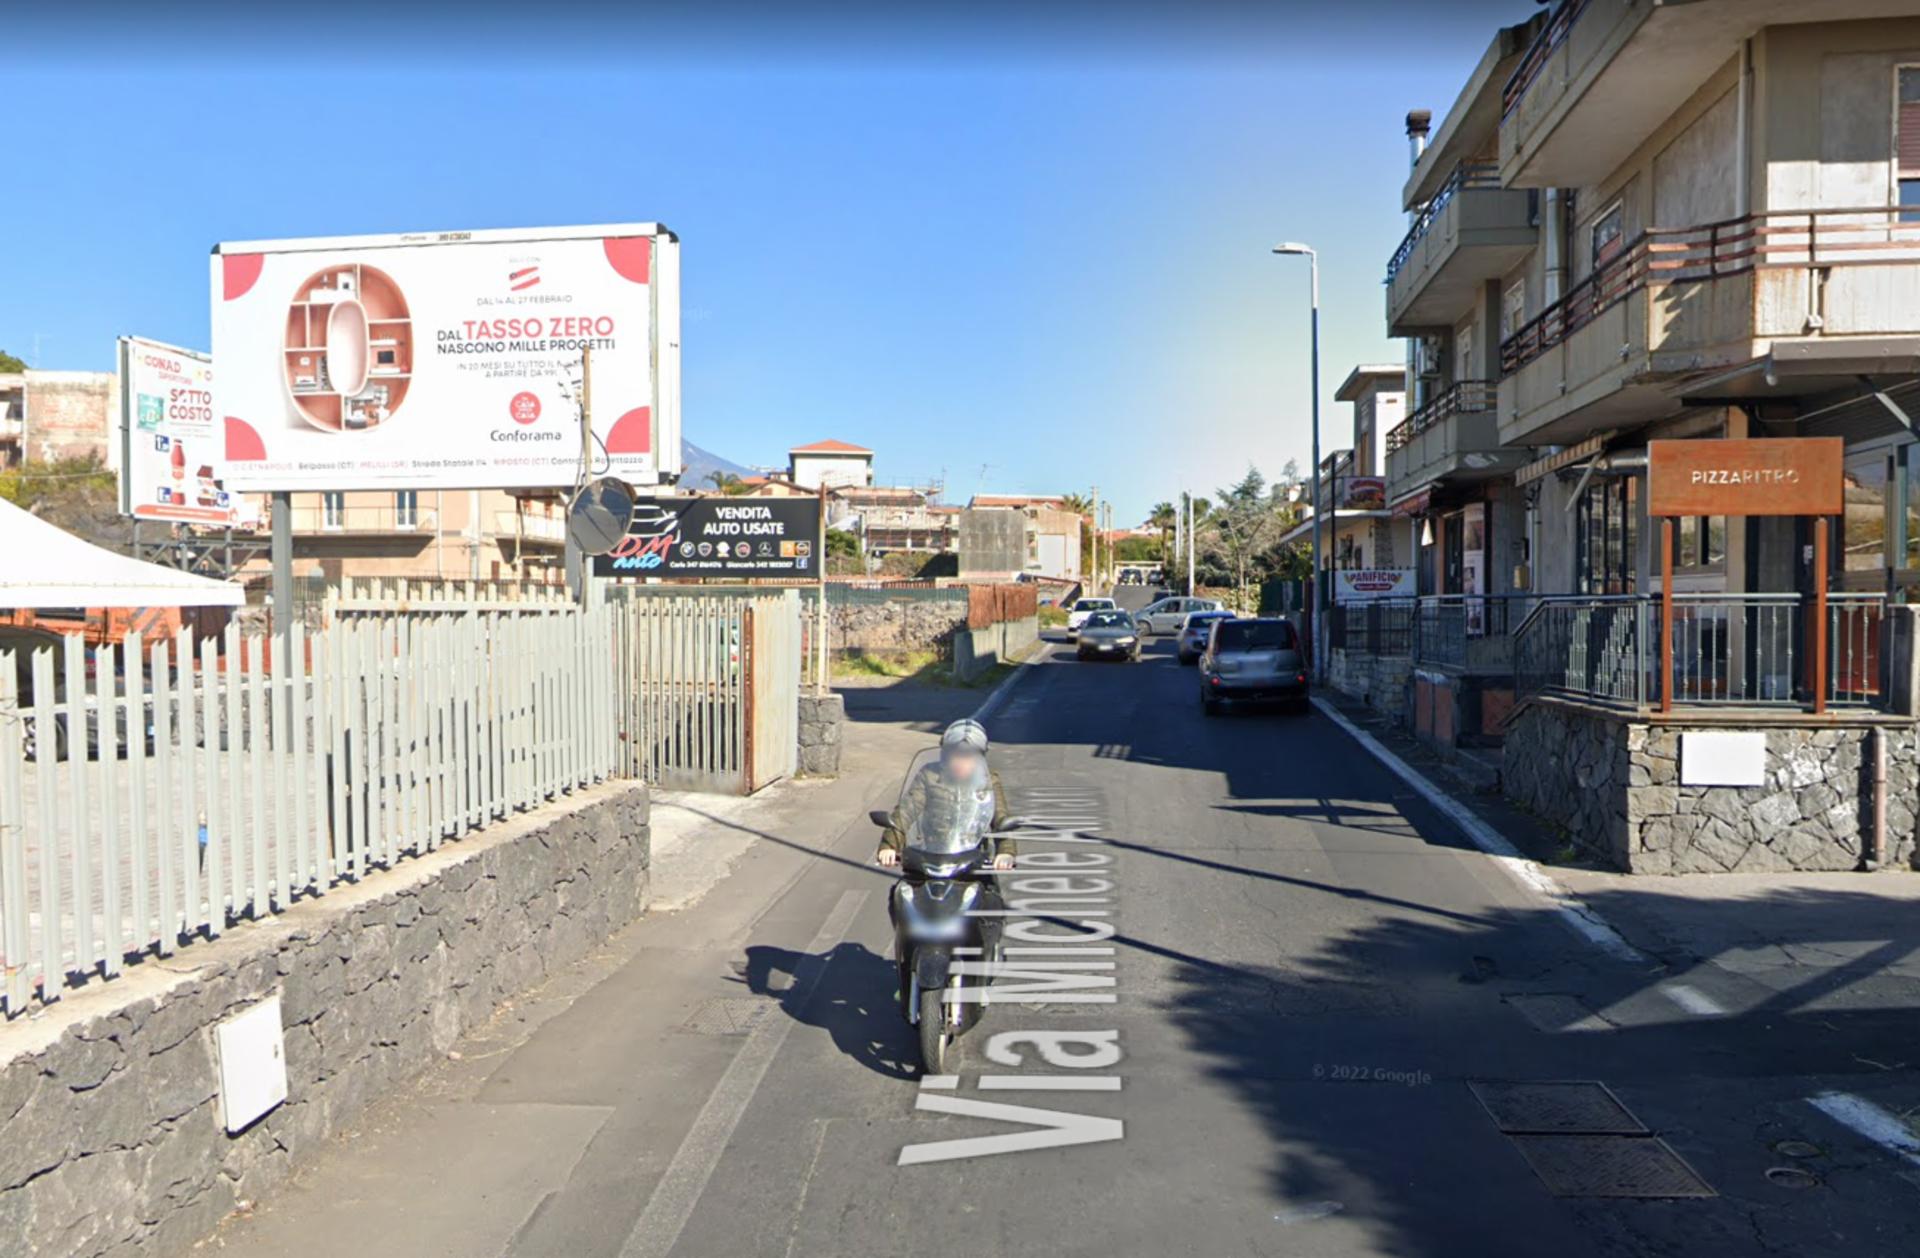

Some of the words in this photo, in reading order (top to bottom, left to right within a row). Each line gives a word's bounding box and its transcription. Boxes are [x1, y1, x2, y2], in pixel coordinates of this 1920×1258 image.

[477, 297, 493, 306] DAL
[505, 297, 516, 305] AL
[518, 296, 528, 304] 27
[529, 294, 573, 304] FEBBRAIO
[437, 330, 463, 342] DAL
[463, 318, 543, 340] TASSO
[549, 316, 615, 338] ZERO
[437, 341, 506, 355] NASCONO
[509, 340, 547, 352] MILLE
[550, 338, 616, 351] PROGETTI
[144, 355, 182, 374] CONAD
[481, 361, 502, 370] MESI
[504, 361, 516, 370] SU
[517, 360, 546, 369] TUTTO
[493, 369, 528, 379] PARTIRE
[530, 369, 542, 378] DA
[169, 404, 213, 421] COSTO
[490, 429, 562, 442] Conforama
[298, 461, 336, 471] Belpasso
[337, 460, 355, 470] (CT)
[411, 459, 439, 468] Strada
[443, 459, 474, 467] Statale
[494, 458, 531, 466] RIPOSTO
[715, 506, 773, 520] VENDITA
[703, 522, 741, 536] AUTO
[743, 522, 785, 536] USATE
[669, 561, 687, 569] Carlo
[687, 561, 698, 569] 347
[726, 561, 755, 569] Giancarlo
[1350, 571, 1397, 582] PANIFICIO
